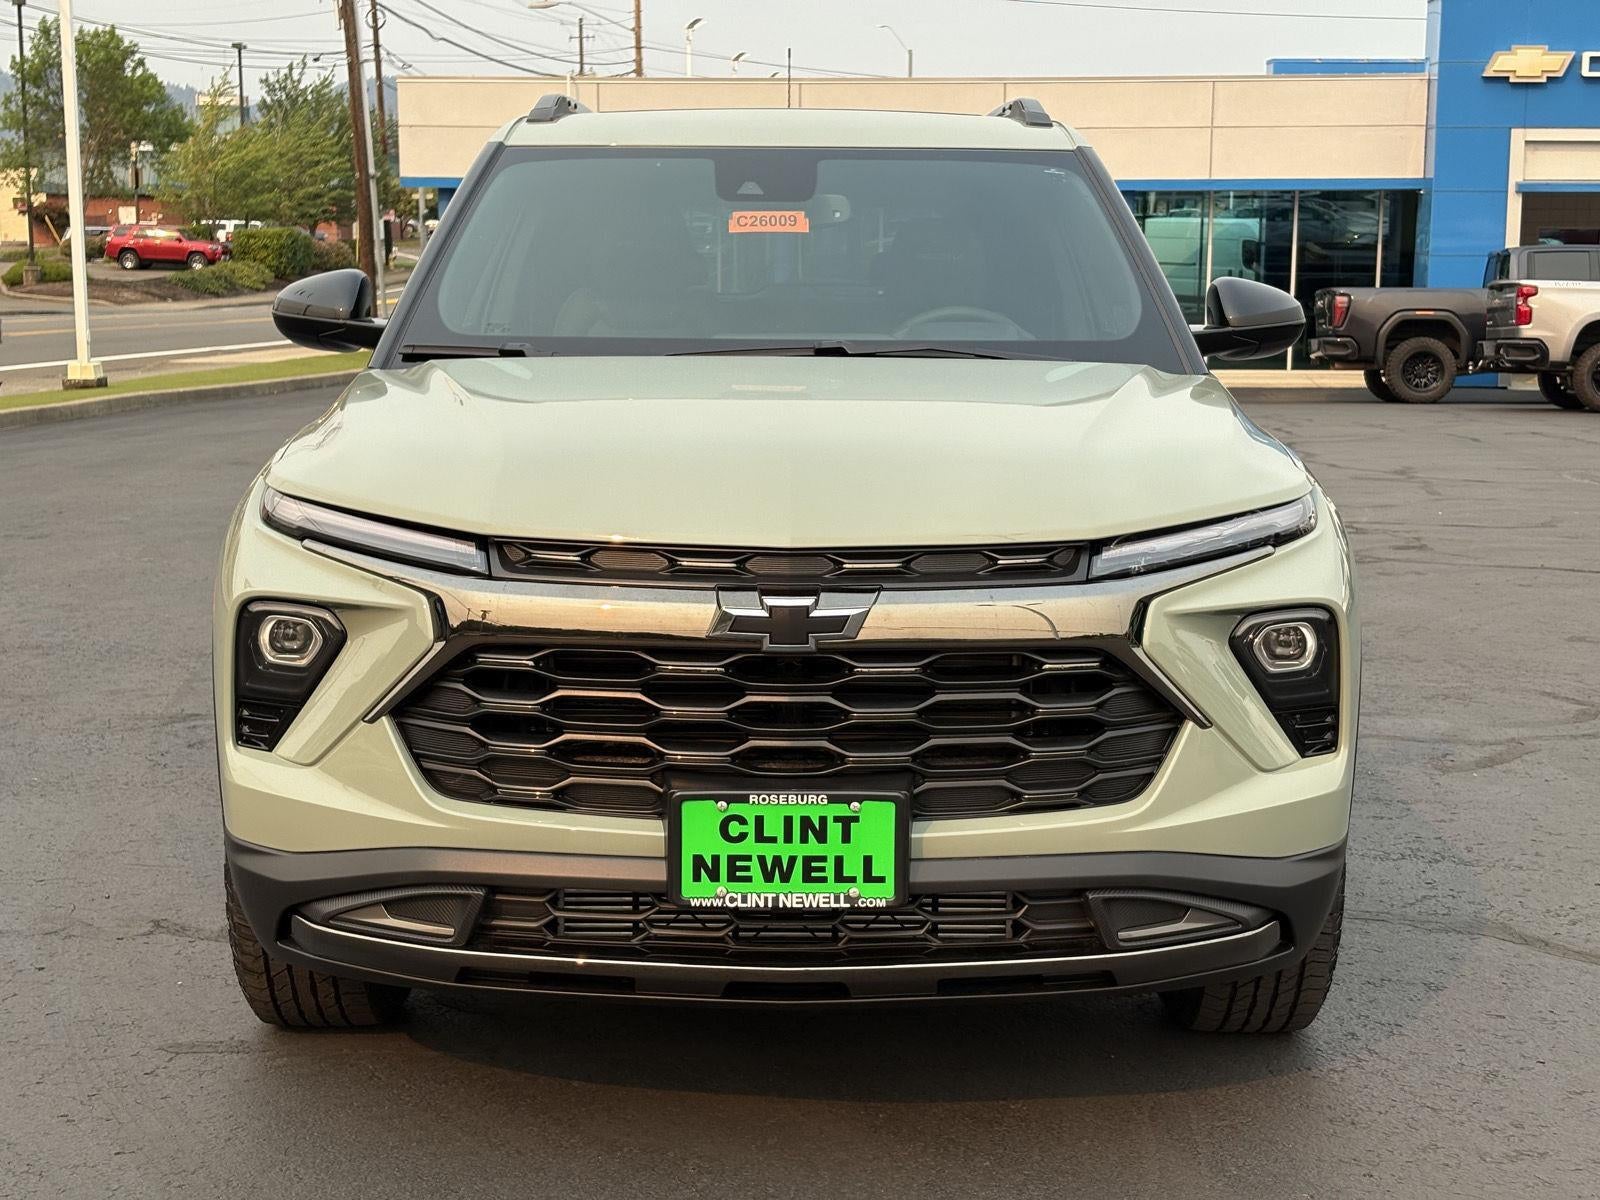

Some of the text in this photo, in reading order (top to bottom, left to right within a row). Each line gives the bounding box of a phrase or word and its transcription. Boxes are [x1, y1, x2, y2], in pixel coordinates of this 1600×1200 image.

[736, 214, 798, 228] C26009
[749, 794, 828, 805] ROSEBURG
[718, 814, 861, 845] CLINT
[691, 854, 887, 884] NEWELL
